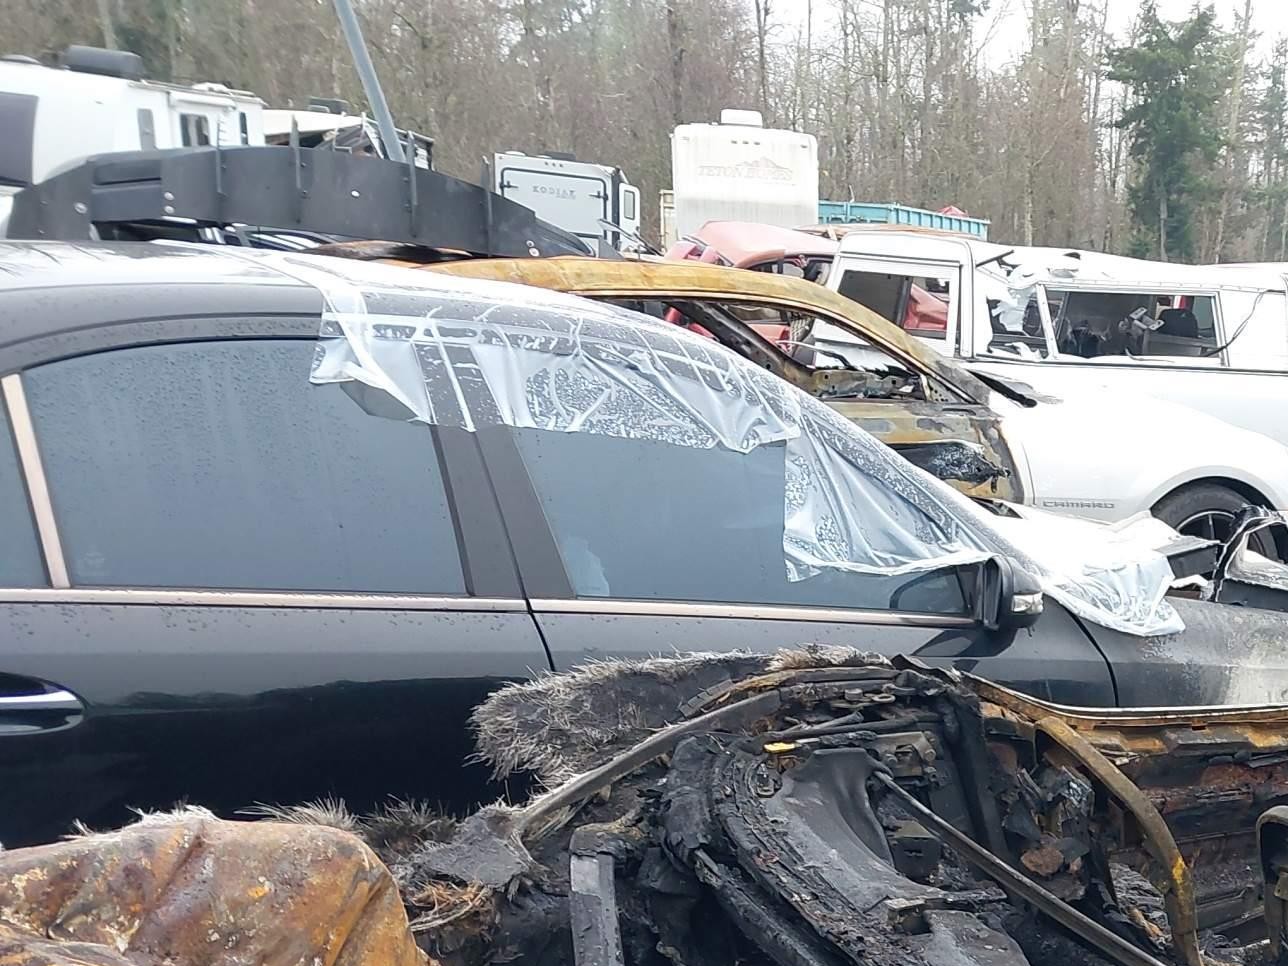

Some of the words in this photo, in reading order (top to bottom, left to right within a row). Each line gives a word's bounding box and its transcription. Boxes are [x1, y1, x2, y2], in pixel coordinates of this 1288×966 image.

[697, 166, 743, 178] TETON
[532, 186, 577, 200] KODIAK
[1042, 500, 1115, 510] CAMARO
